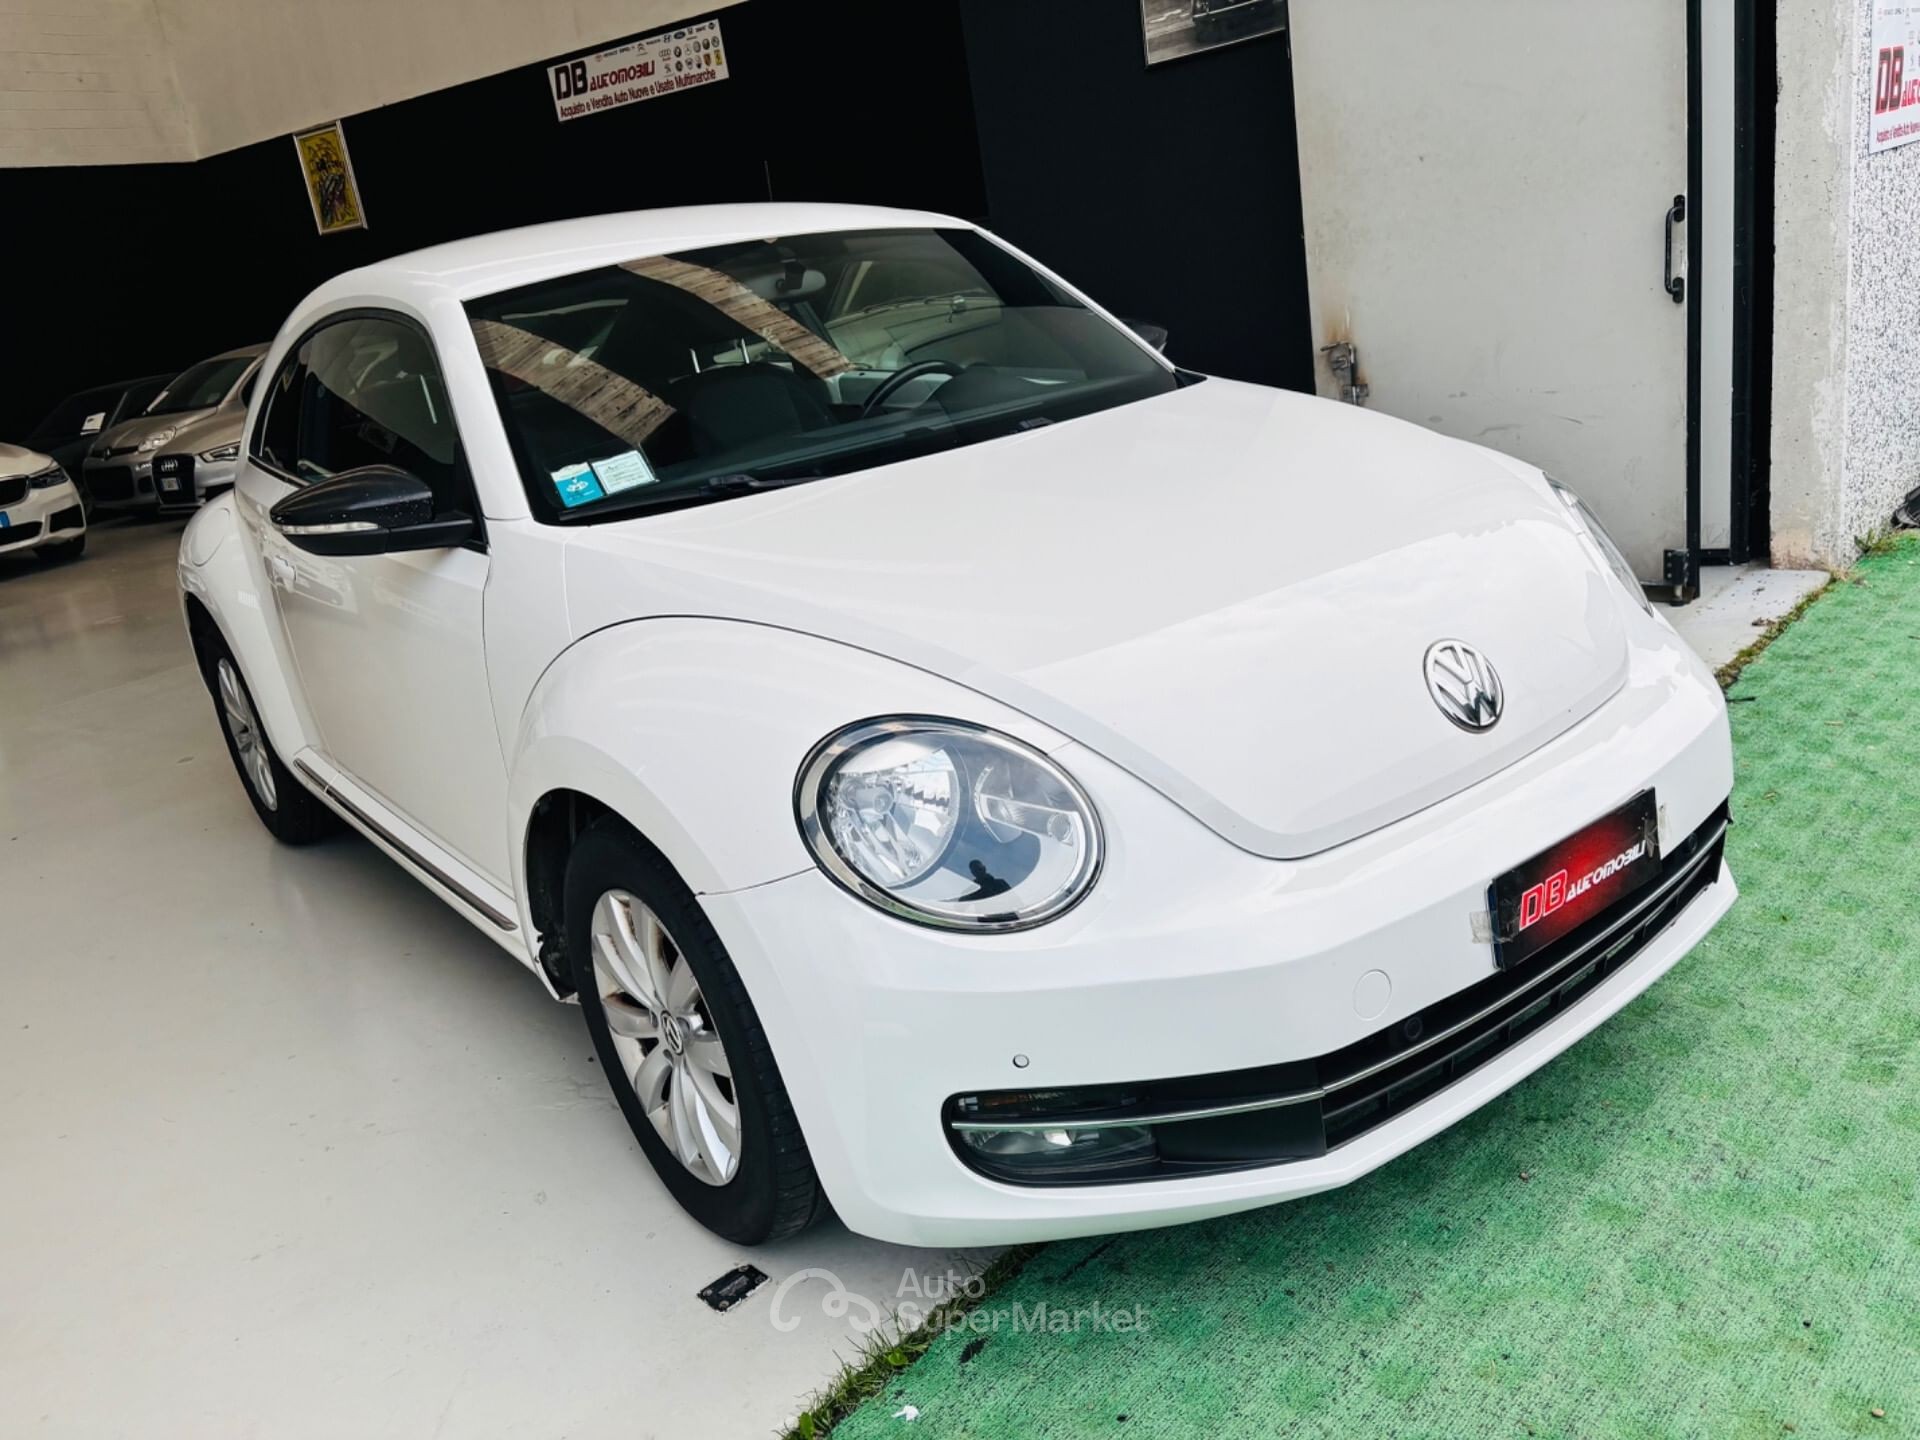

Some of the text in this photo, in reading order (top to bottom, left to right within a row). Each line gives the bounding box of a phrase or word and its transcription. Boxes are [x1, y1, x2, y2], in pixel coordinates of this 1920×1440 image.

[554, 60, 588, 100] DB
[586, 101, 591, 111] e
[590, 94, 613, 110] Vendita
[614, 90, 629, 104] Auto
[649, 83, 655, 95] e
[675, 68, 716, 88] Multimarche
[1875, 45, 1904, 114] DB
[1519, 868, 1568, 931] DB
